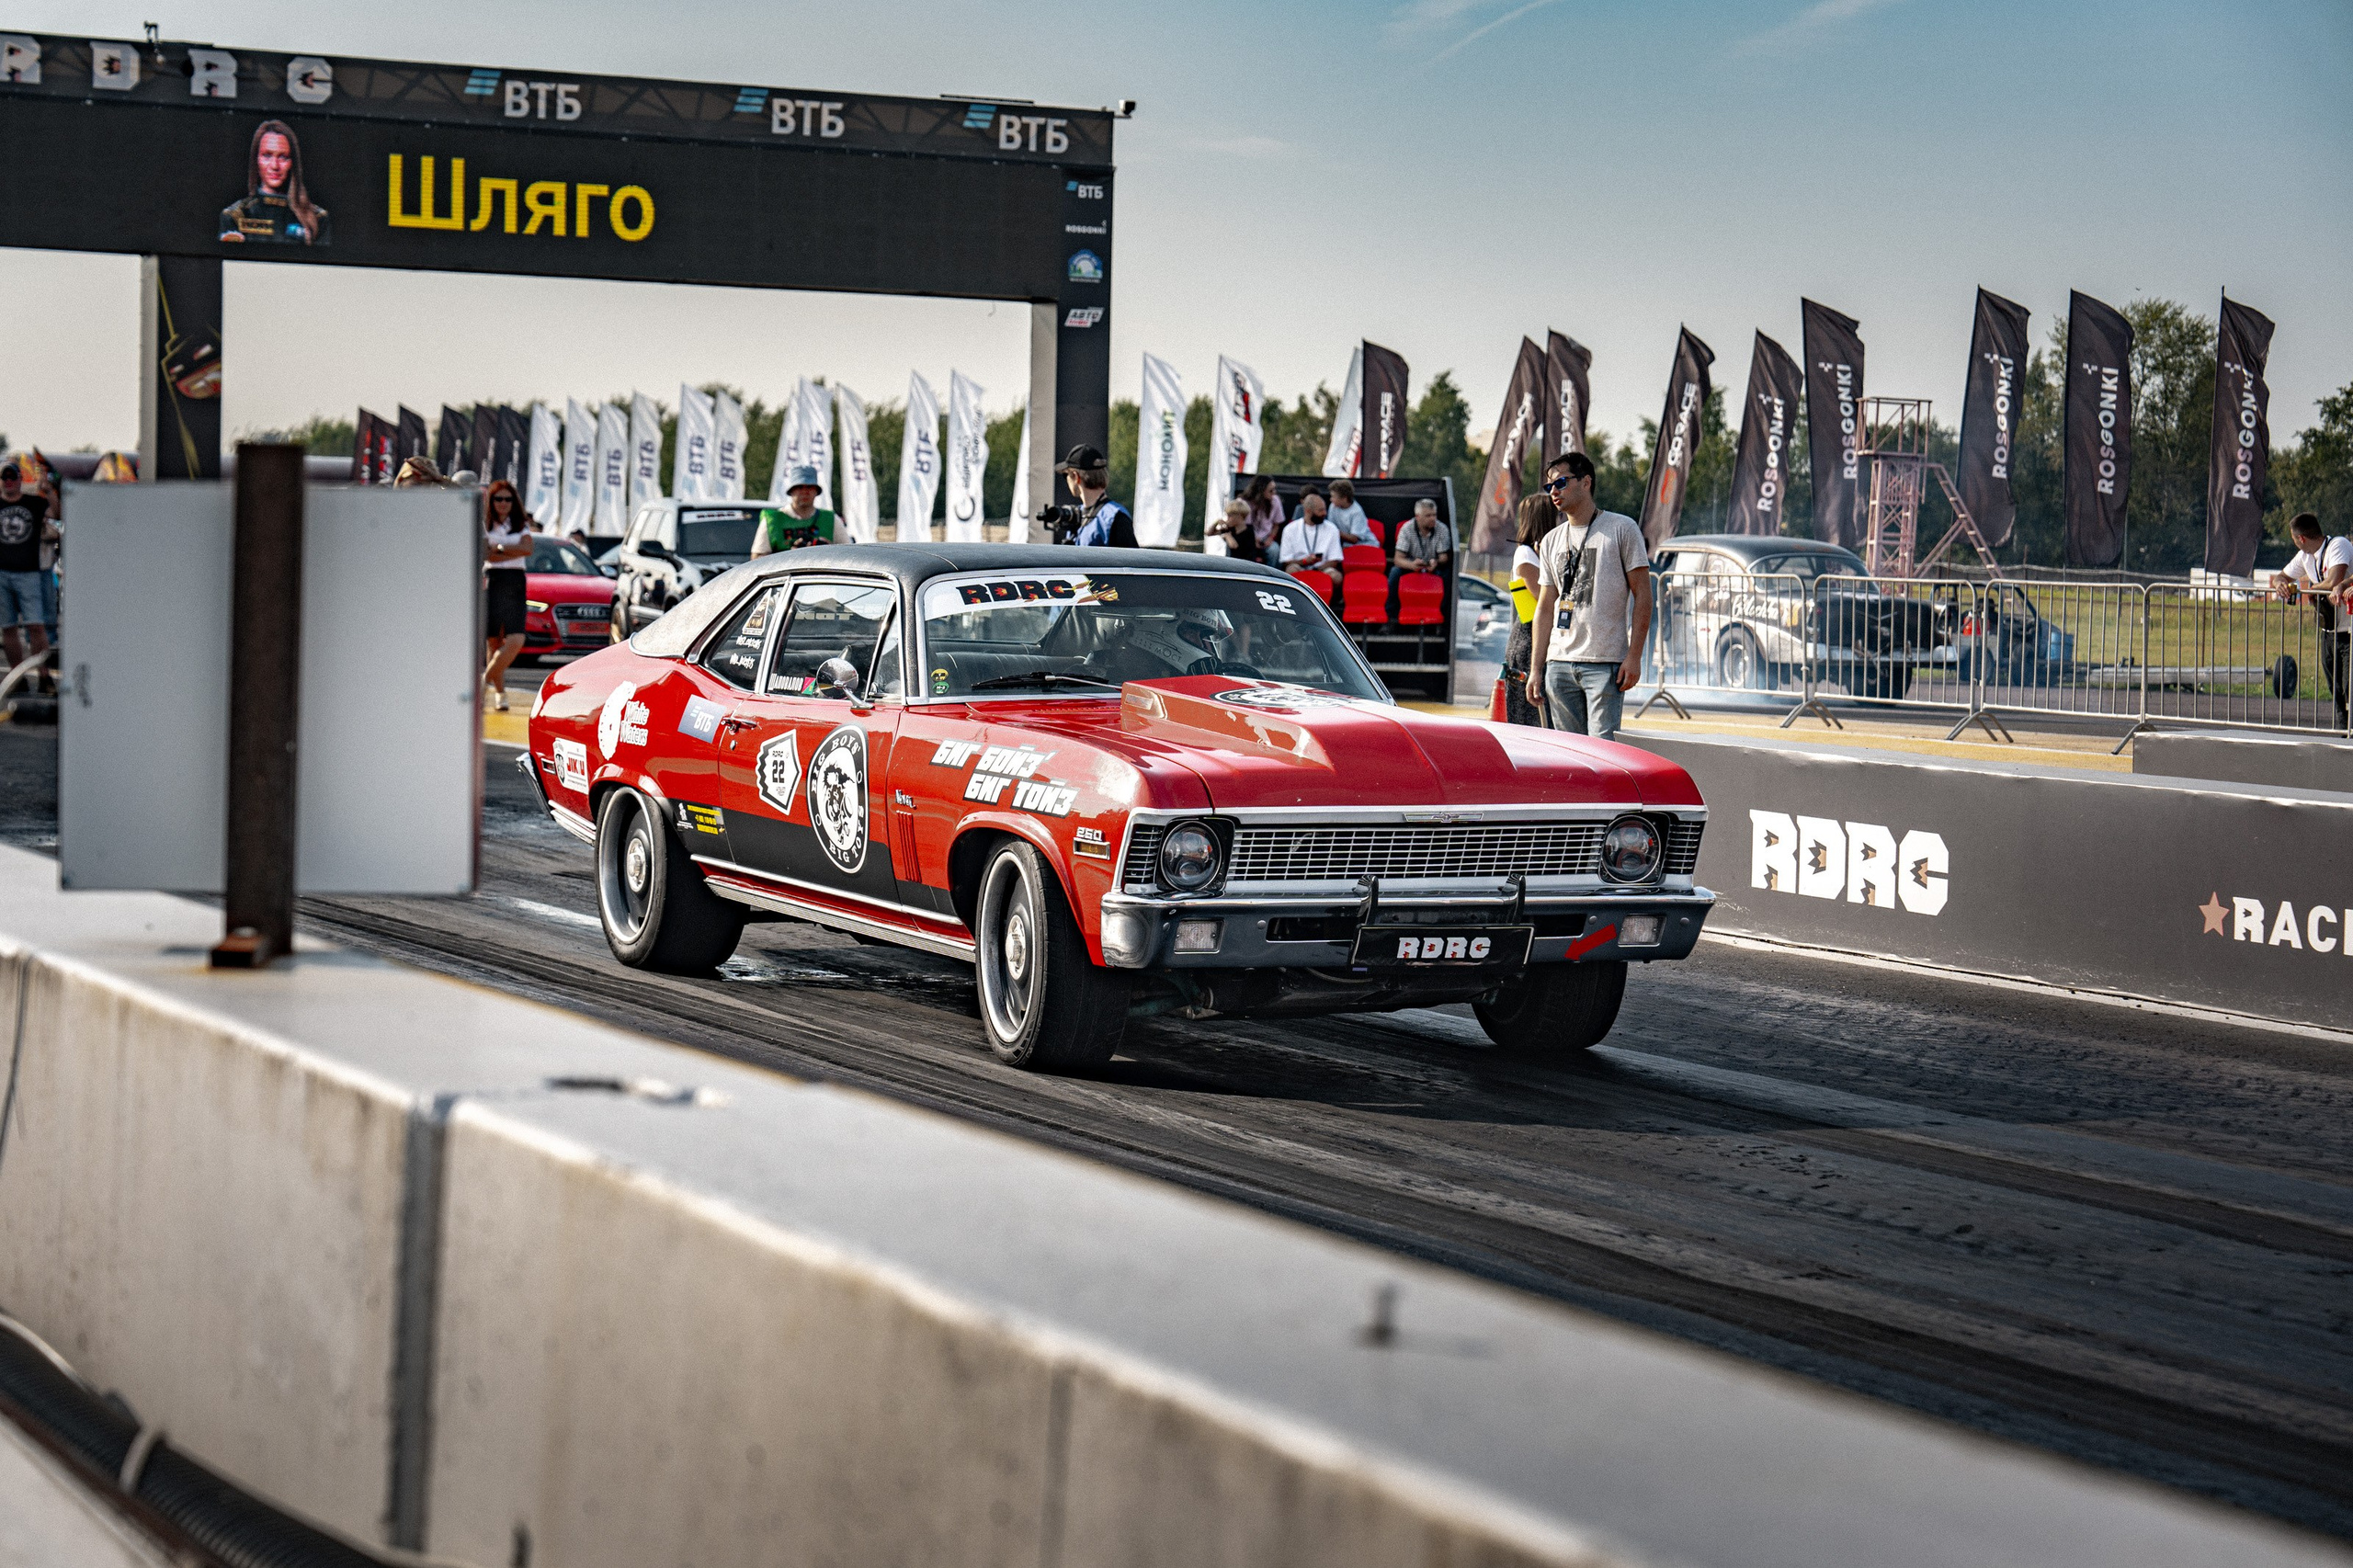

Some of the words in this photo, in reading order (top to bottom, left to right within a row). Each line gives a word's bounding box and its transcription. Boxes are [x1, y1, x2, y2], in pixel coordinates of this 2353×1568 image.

[505, 79, 582, 119] ВТБ
[771, 97, 845, 138] ВТБ
[999, 114, 1069, 153] ВТБ
[388, 153, 655, 242] Шляго
[1078, 185, 1103, 199] ВТБ
[1836, 364, 1857, 480] ROSGONKI
[1993, 357, 2014, 479] ROSGONKI
[2097, 366, 2119, 494] ROSGONKI
[2233, 369, 2255, 500] ROSGONKI
[574, 443, 591, 481] ВТБ
[607, 448, 622, 487] ВТБ
[689, 435, 705, 475] ВТБ
[720, 439, 736, 480] ВТБ
[1756, 397, 1785, 512] ROSGONKI
[956, 579, 1076, 605] RDRC
[1255, 590, 1296, 616] 22
[693, 710, 715, 733] ВТБ
[772, 760, 785, 783] 22
[811, 752, 826, 795] BIG
[930, 739, 983, 769] БИГ
[963, 772, 1012, 805] БИГ
[1011, 778, 1080, 818] ТОЙЗ
[828, 840, 850, 863] BIG
[1076, 826, 1103, 841] 250
[1749, 809, 1949, 916] RDRC
[1396, 937, 1492, 959] RDRC
